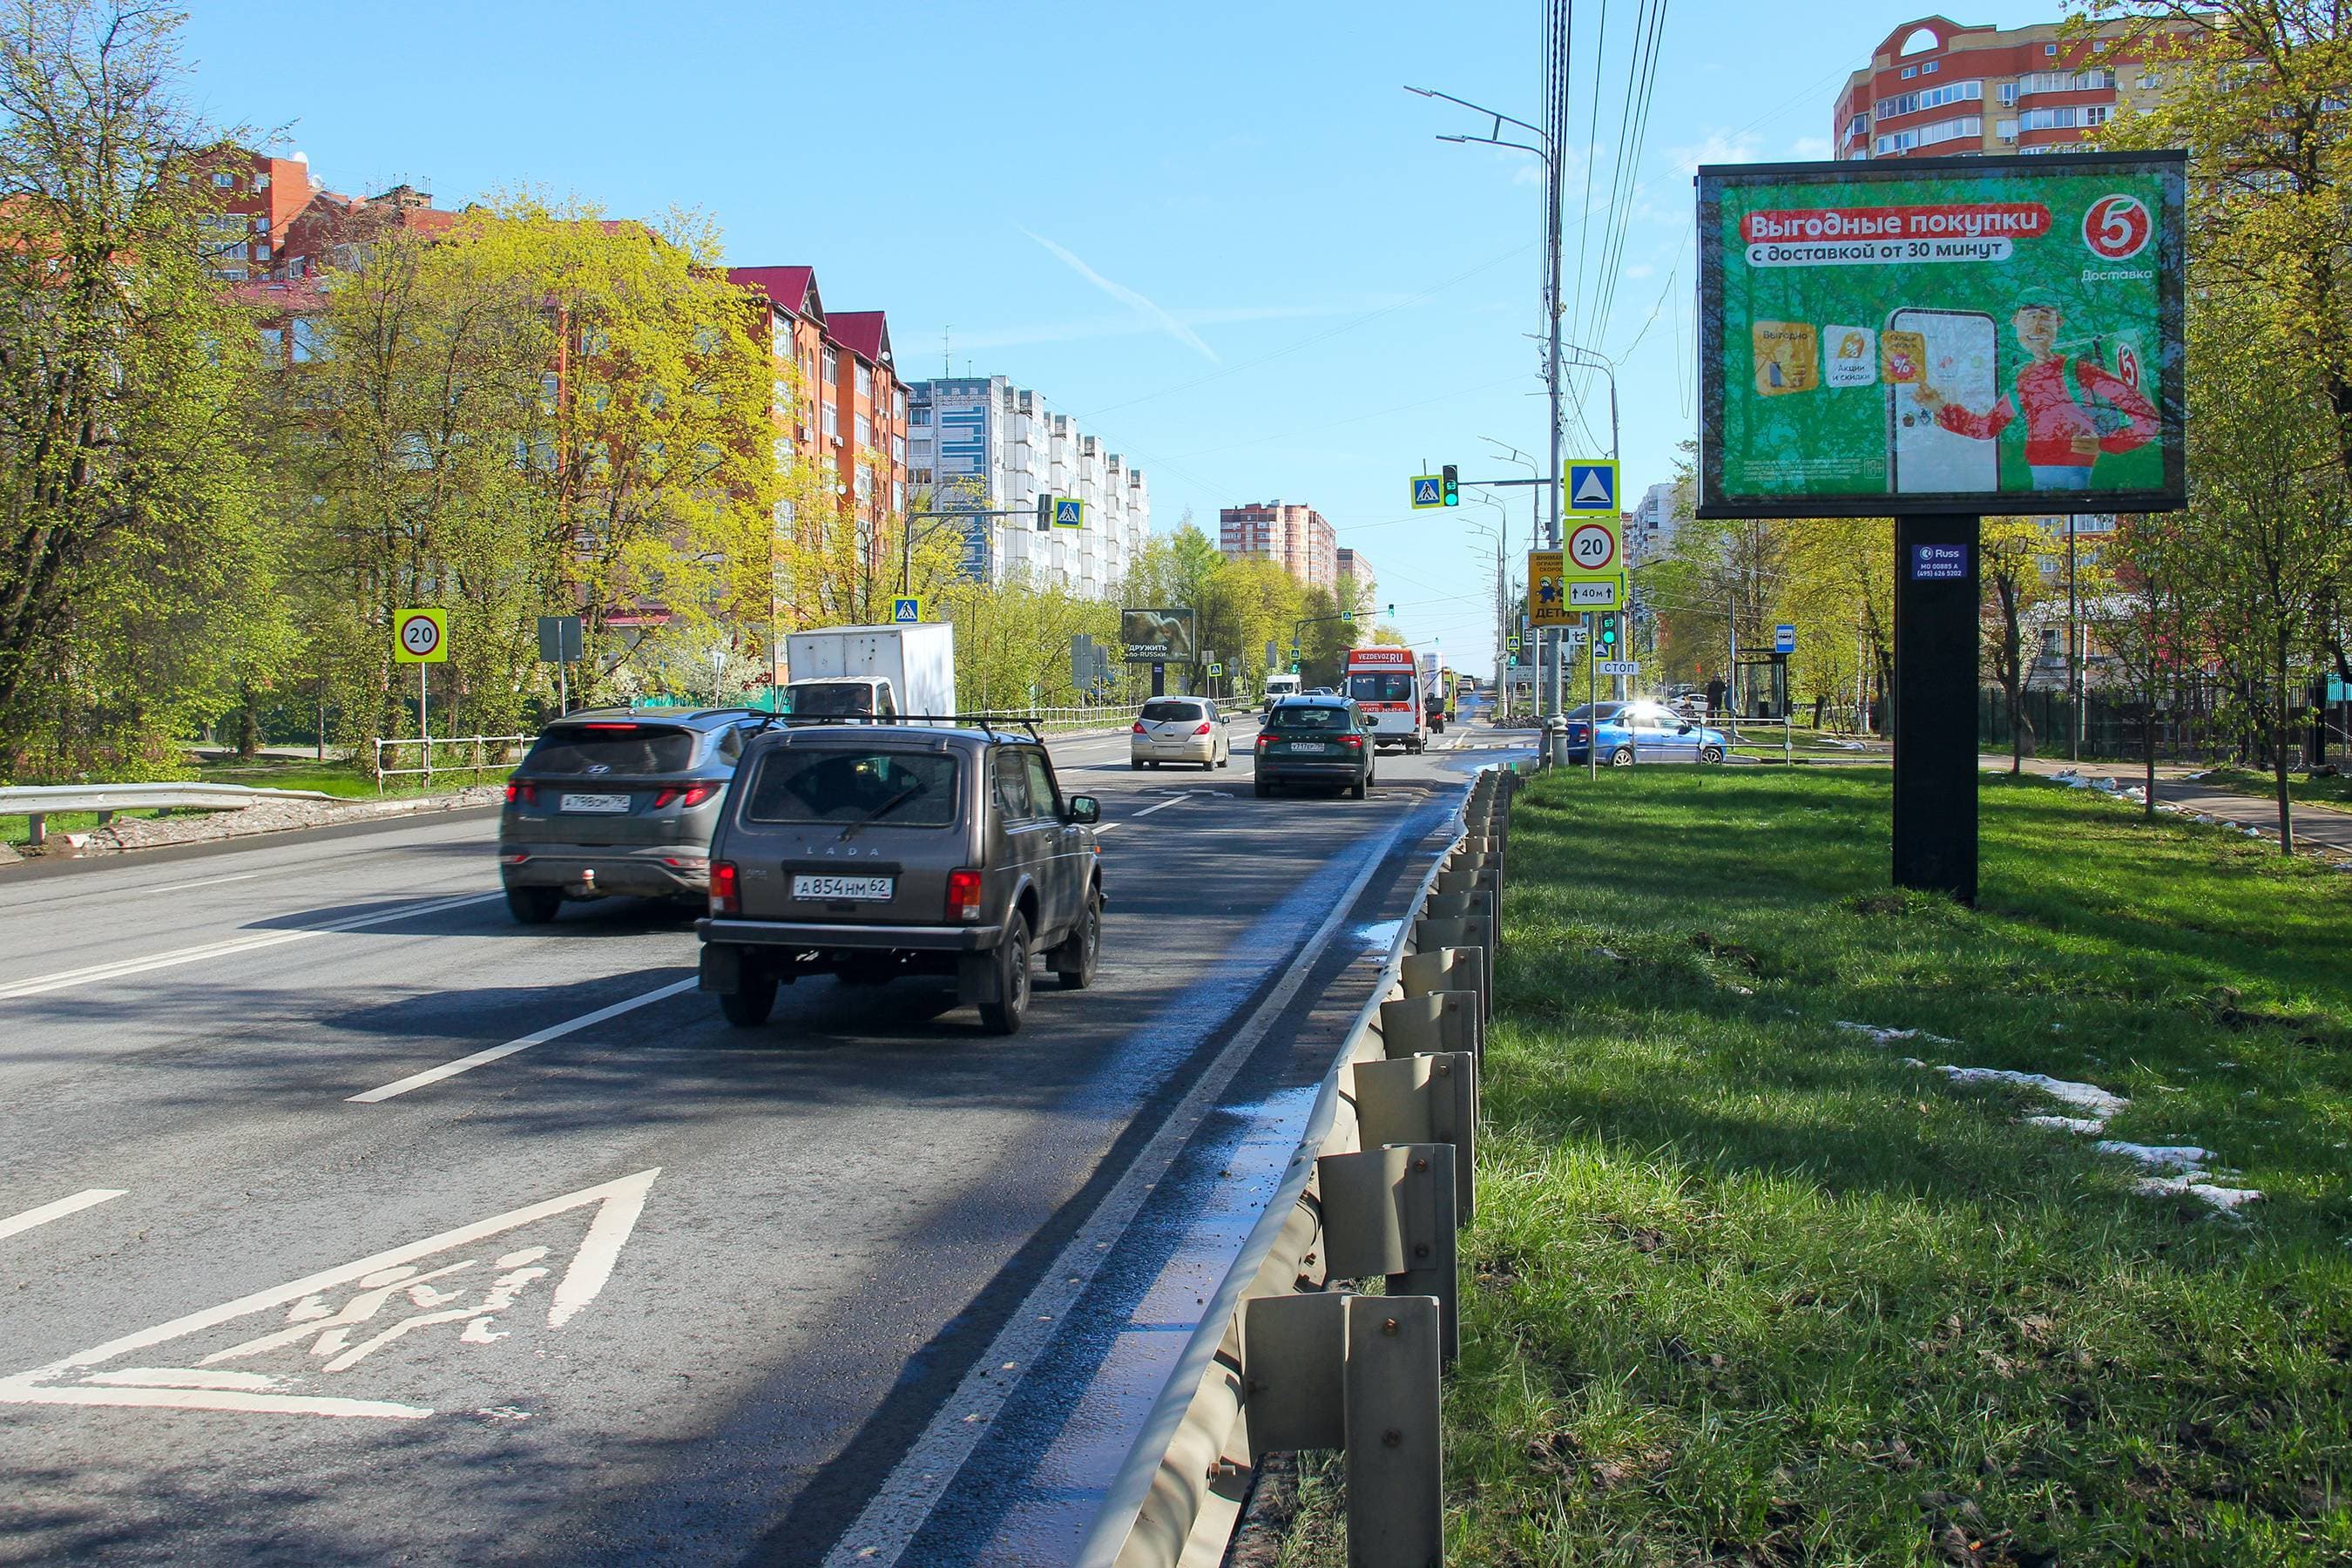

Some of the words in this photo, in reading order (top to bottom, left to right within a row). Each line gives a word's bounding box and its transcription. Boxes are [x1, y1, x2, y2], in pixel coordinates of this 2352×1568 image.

[1751, 212, 1902, 238] Выгодные
[1910, 213, 2038, 237] покупки
[1752, 249, 1762, 261] с
[1767, 244, 1875, 261] доставкой
[1880, 245, 1903, 259] от
[1908, 241, 1930, 257] 30
[1936, 243, 2002, 260] минут
[2081, 269, 2153, 282] Доставка
[1763, 330, 1808, 341] Выгодно
[1840, 373, 1870, 382] скидки
[1580, 538, 1603, 556] 20
[1935, 549, 1959, 558] Russ
[409, 626, 433, 644] 20
[1604, 663, 1635, 672] СТОП
[806, 846, 879, 856] LADA
